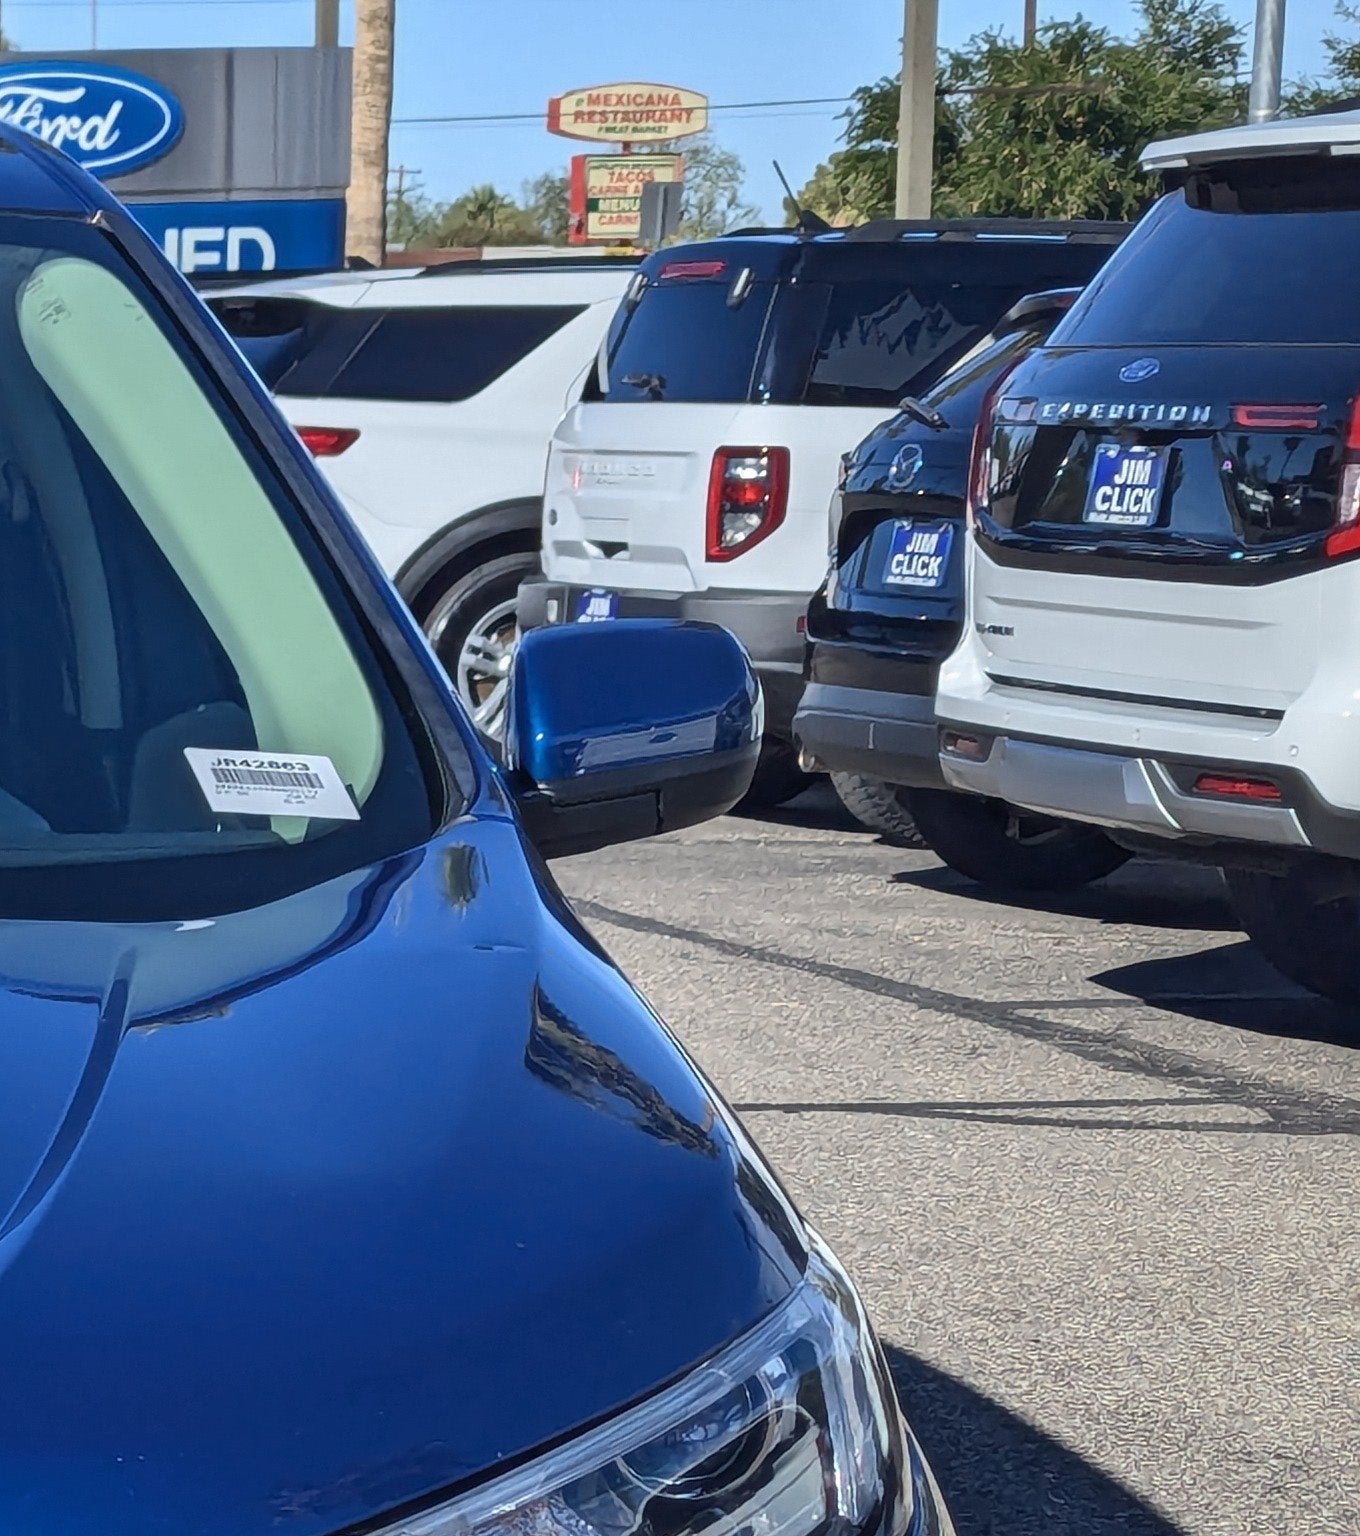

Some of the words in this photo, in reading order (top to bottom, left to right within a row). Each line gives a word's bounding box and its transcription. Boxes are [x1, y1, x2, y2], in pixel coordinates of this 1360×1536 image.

[587, 93, 682, 107] MEXICANA
[573, 109, 694, 124] RESTAURANT
[608, 170, 655, 183] TACOS
[1042, 403, 1212, 424] EXPEDITION
[1114, 459, 1152, 485] JIM
[1095, 486, 1157, 513] CLICK
[906, 532, 939, 555] JIM
[891, 553, 943, 577] CLICK
